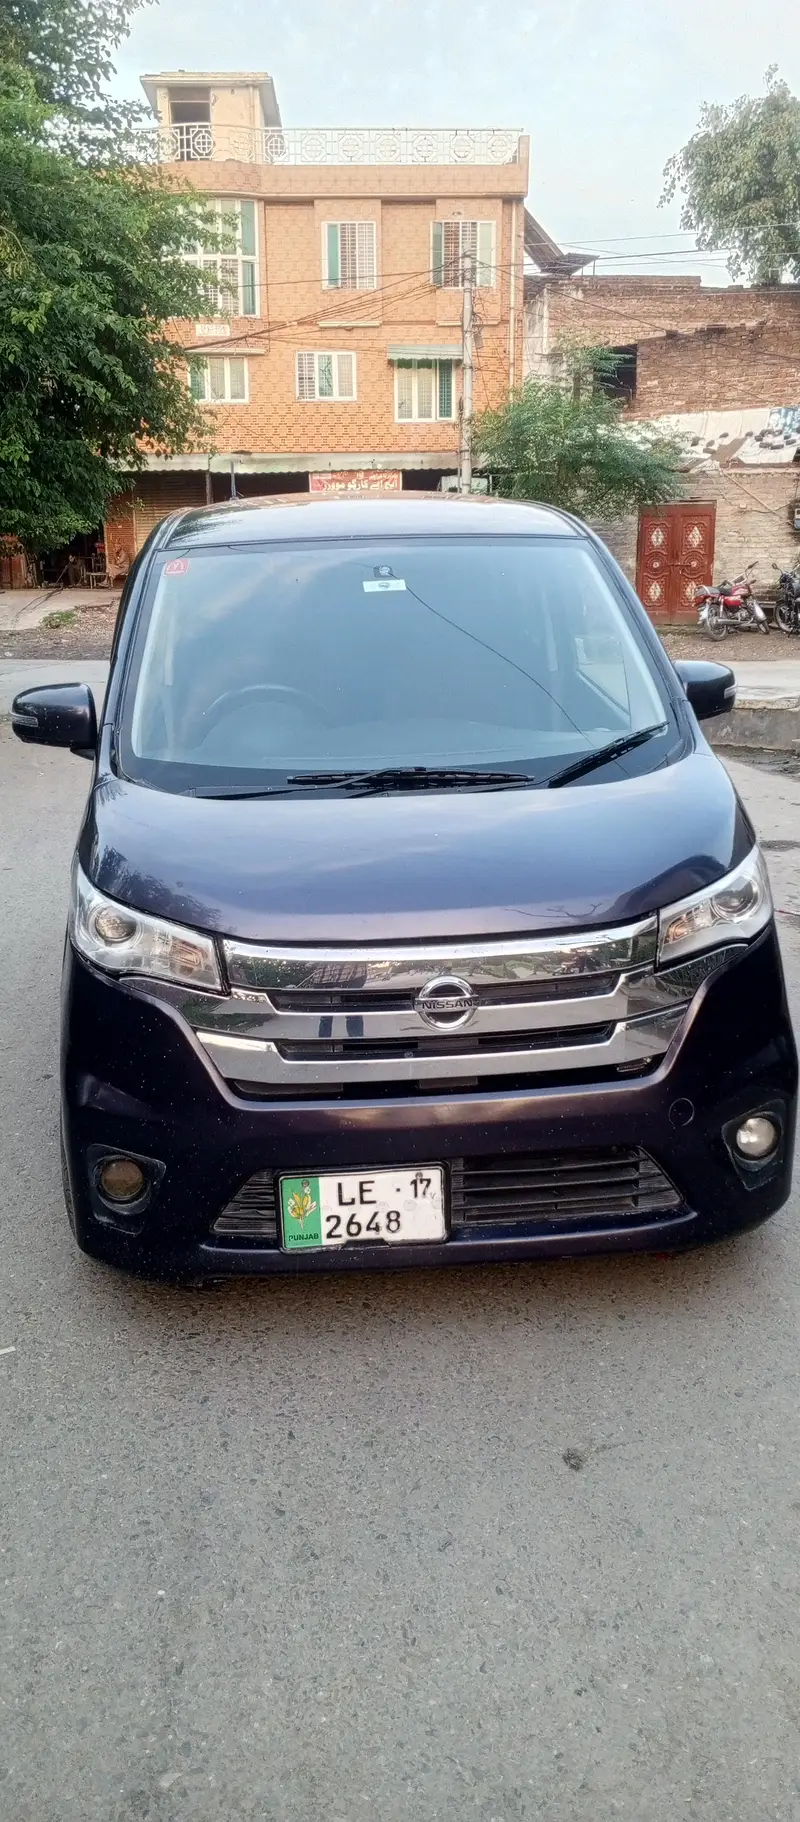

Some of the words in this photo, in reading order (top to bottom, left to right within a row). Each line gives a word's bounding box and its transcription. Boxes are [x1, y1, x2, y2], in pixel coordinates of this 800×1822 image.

[422, 1000, 473, 1009] NISSAN
[337, 1180, 377, 1206] LE
[410, 1178, 431, 1199] 17
[325, 1210, 401, 1239] 2648
[288, 1233, 319, 1242] PUNJAB
